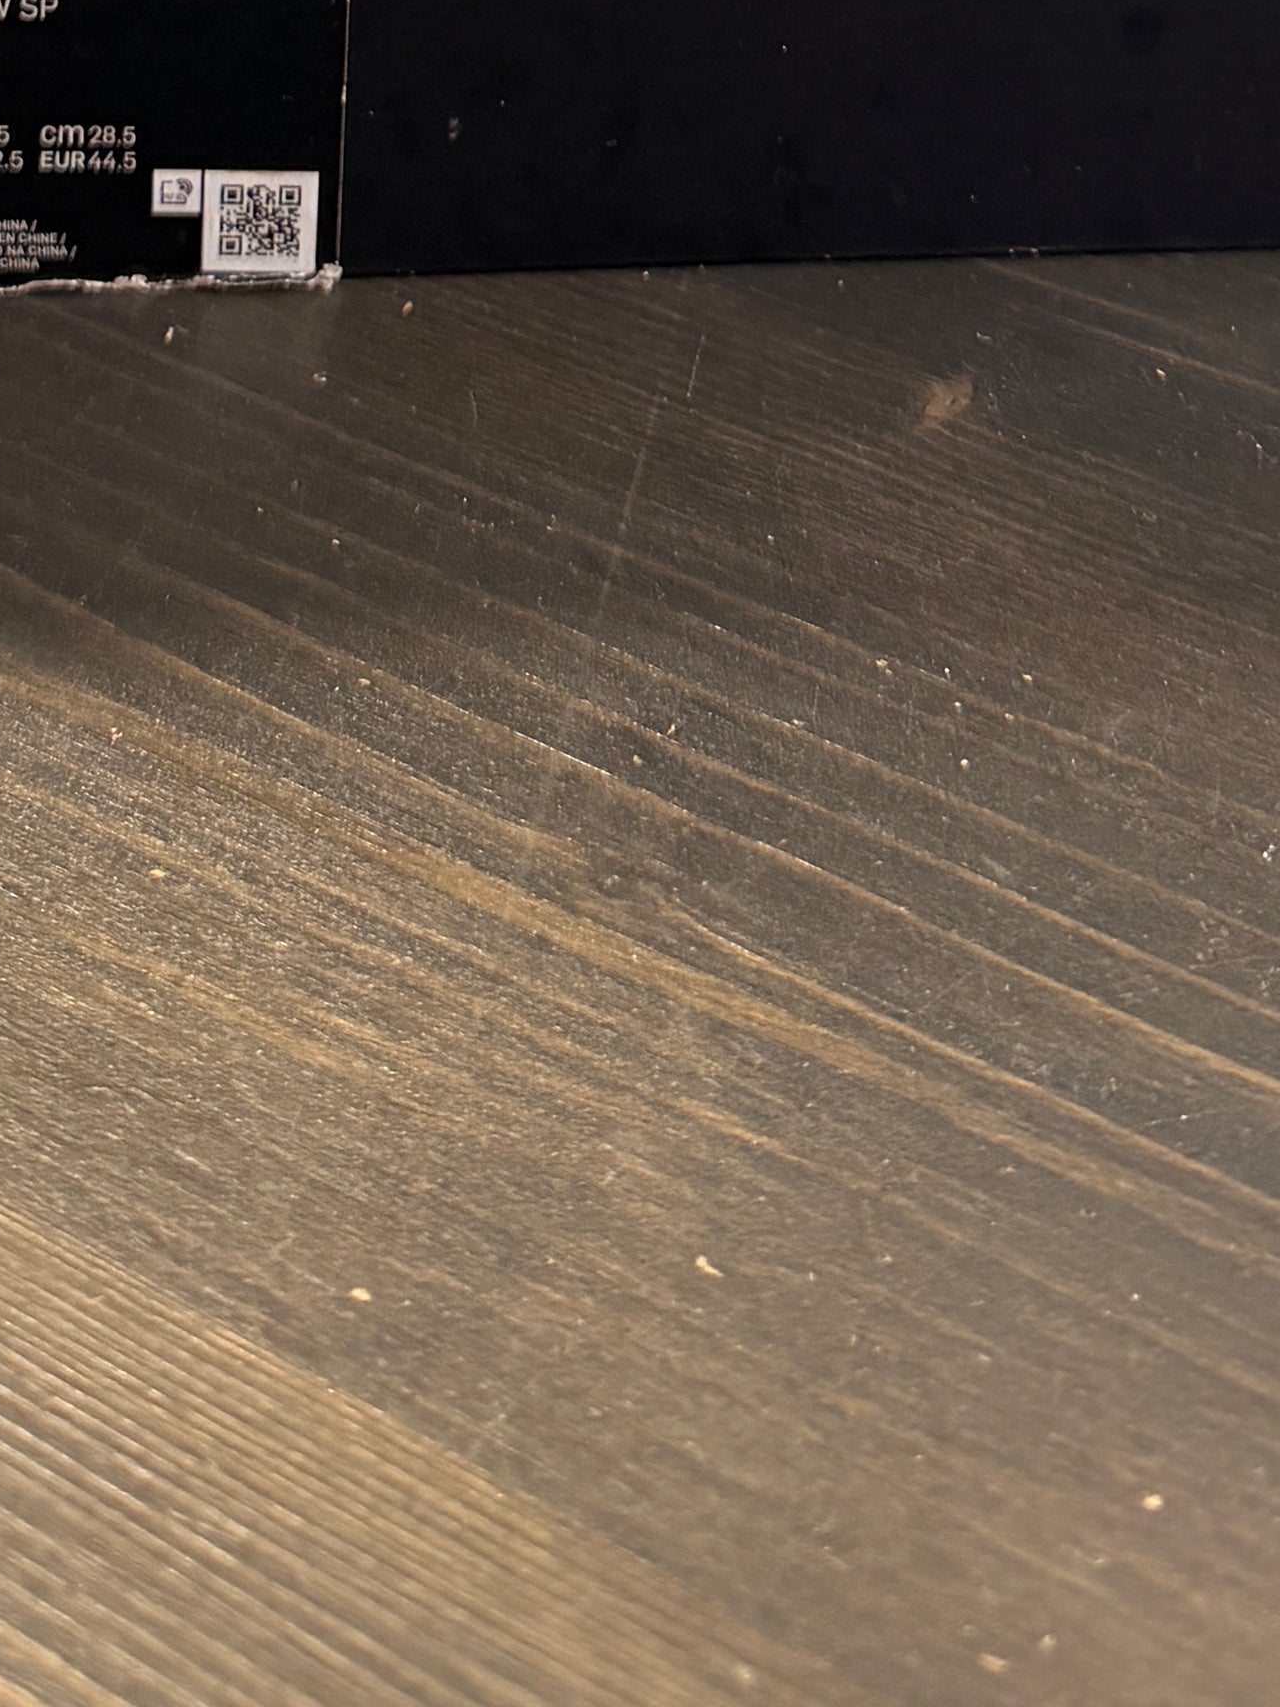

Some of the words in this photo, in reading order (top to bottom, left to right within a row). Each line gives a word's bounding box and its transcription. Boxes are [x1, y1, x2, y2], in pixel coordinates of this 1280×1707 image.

[86, 125, 137, 149] 28.5
[37, 149, 86, 174] EUR
[86, 150, 137, 175] 44.5
[18, 232, 58, 244] CHINE
[6, 245, 24, 258] NA
[27, 245, 68, 260] CHINA
